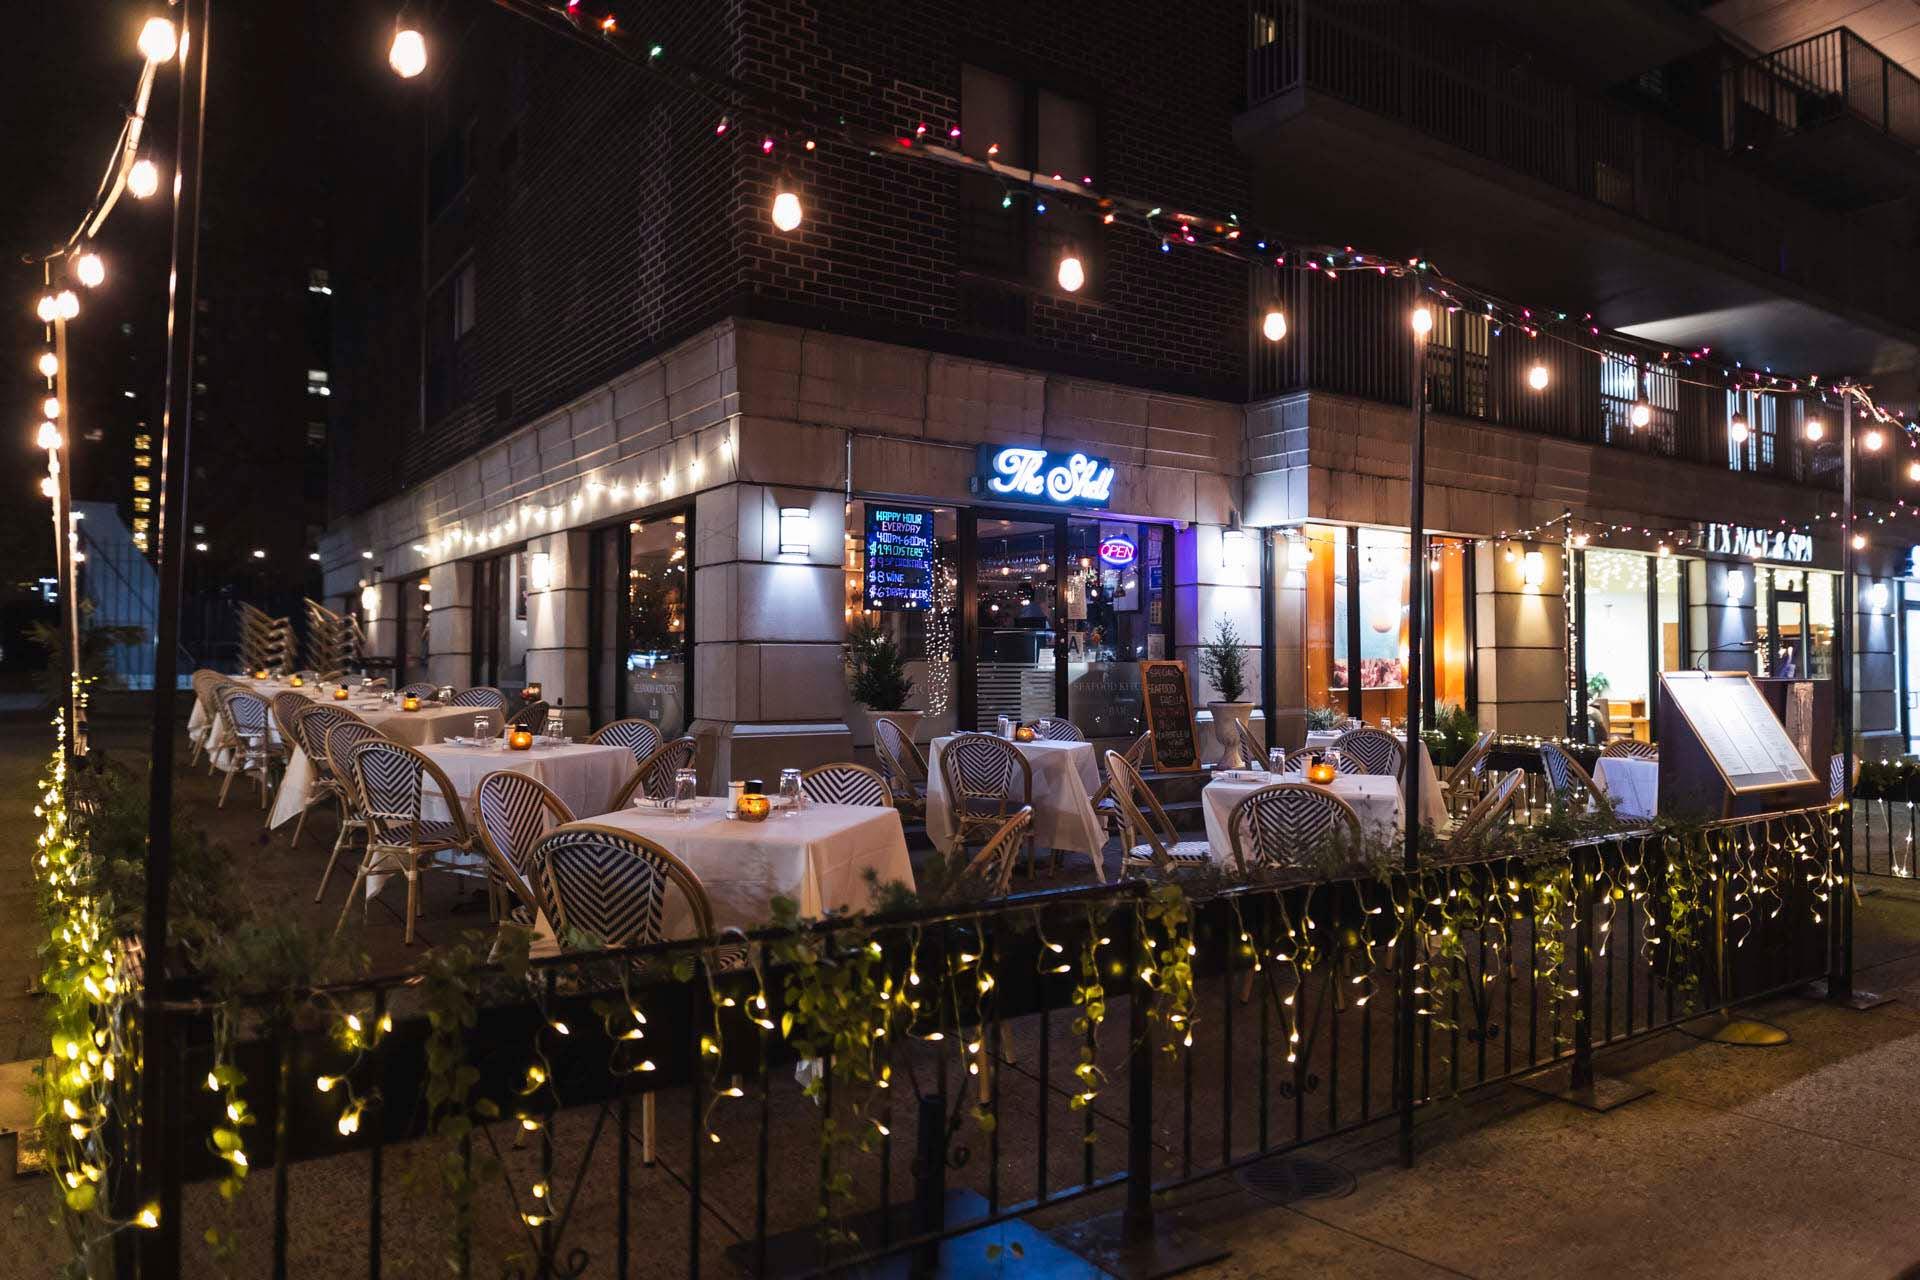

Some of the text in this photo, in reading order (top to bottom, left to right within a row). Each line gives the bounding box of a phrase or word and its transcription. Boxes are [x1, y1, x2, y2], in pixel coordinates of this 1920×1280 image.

[991, 448, 1115, 502] The Shell
[876, 511, 922, 524] HAPPY HOUR
[882, 521, 921, 534] EVERYDAY
[893, 545, 923, 558] OYSTERS
[1100, 544, 1134, 558] OPEN
[1788, 533, 1813, 562] SPA
[886, 572, 905, 583] WINE
[1068, 635, 1080, 654] A
